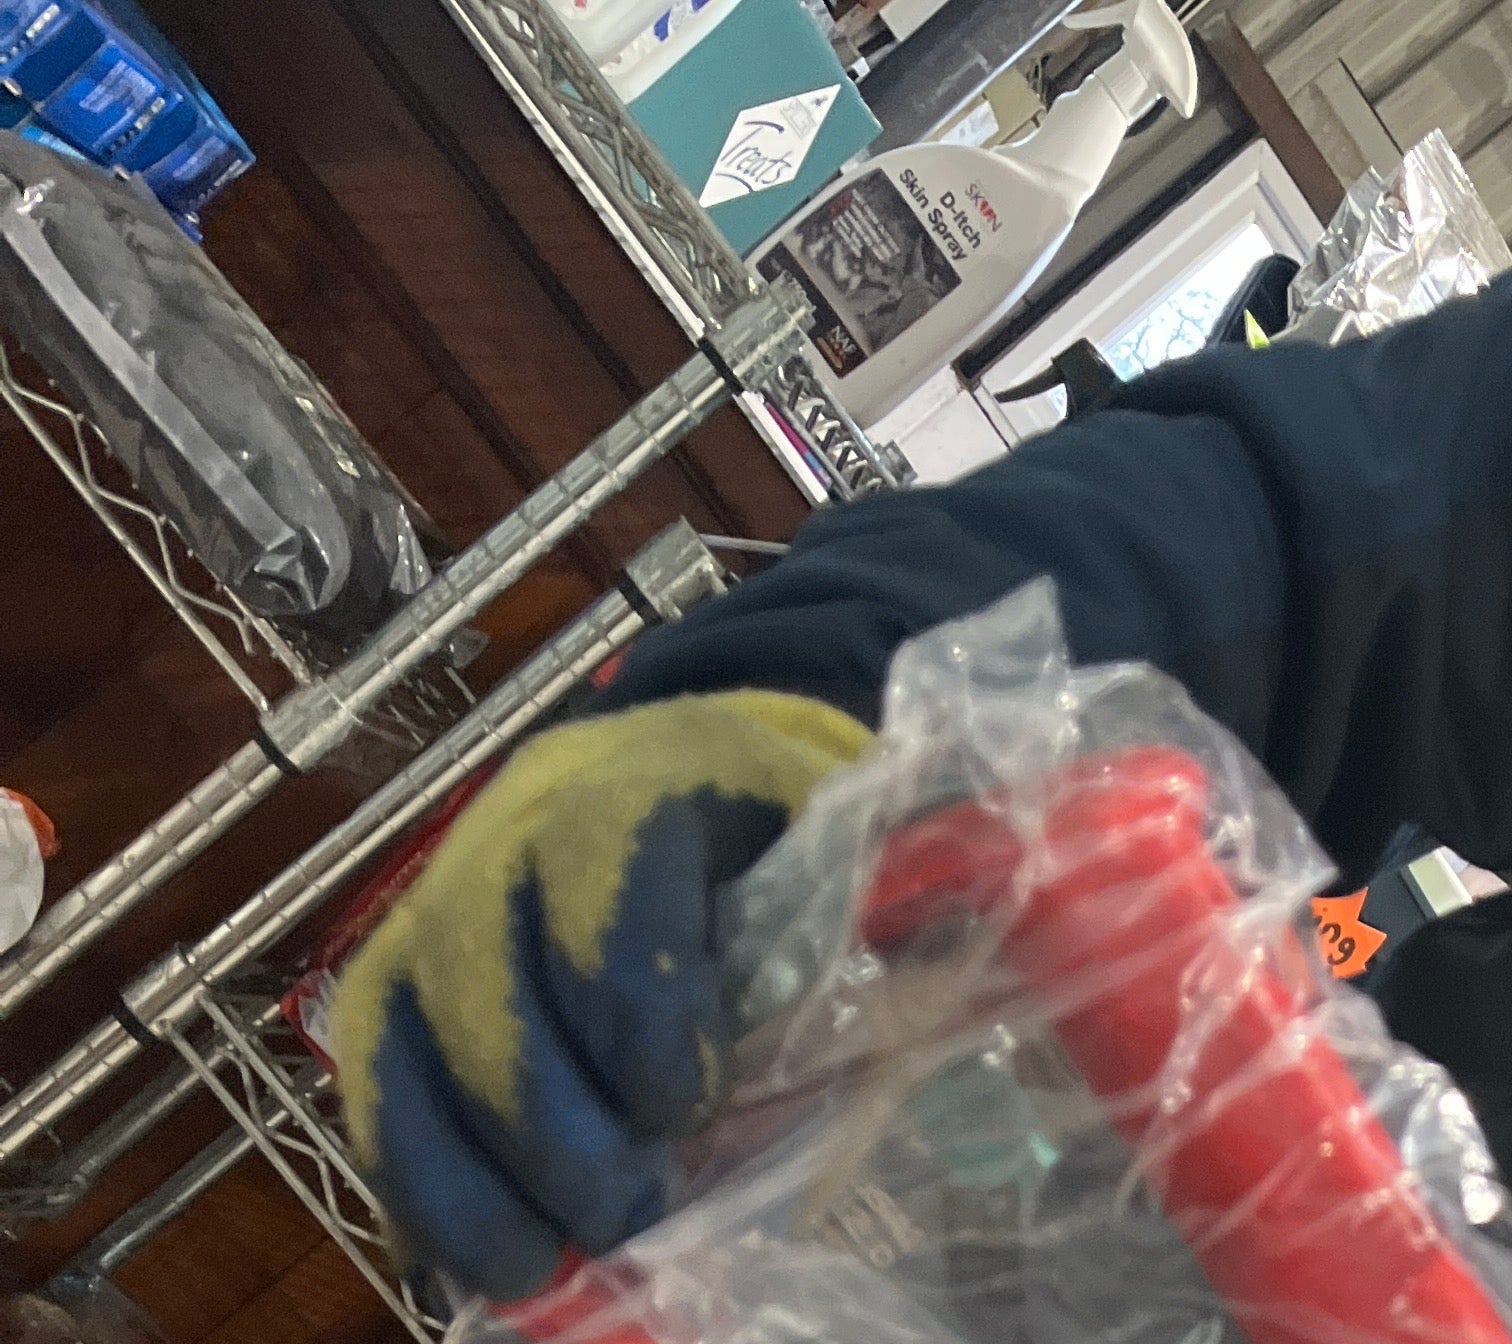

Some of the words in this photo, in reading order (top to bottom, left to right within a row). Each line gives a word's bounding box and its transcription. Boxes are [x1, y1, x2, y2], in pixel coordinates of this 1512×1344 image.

[720, 121, 792, 184] Treats
[900, 168, 929, 208] Skin
[928, 206, 967, 262] Spray
[940, 191, 981, 249] D-Itch
